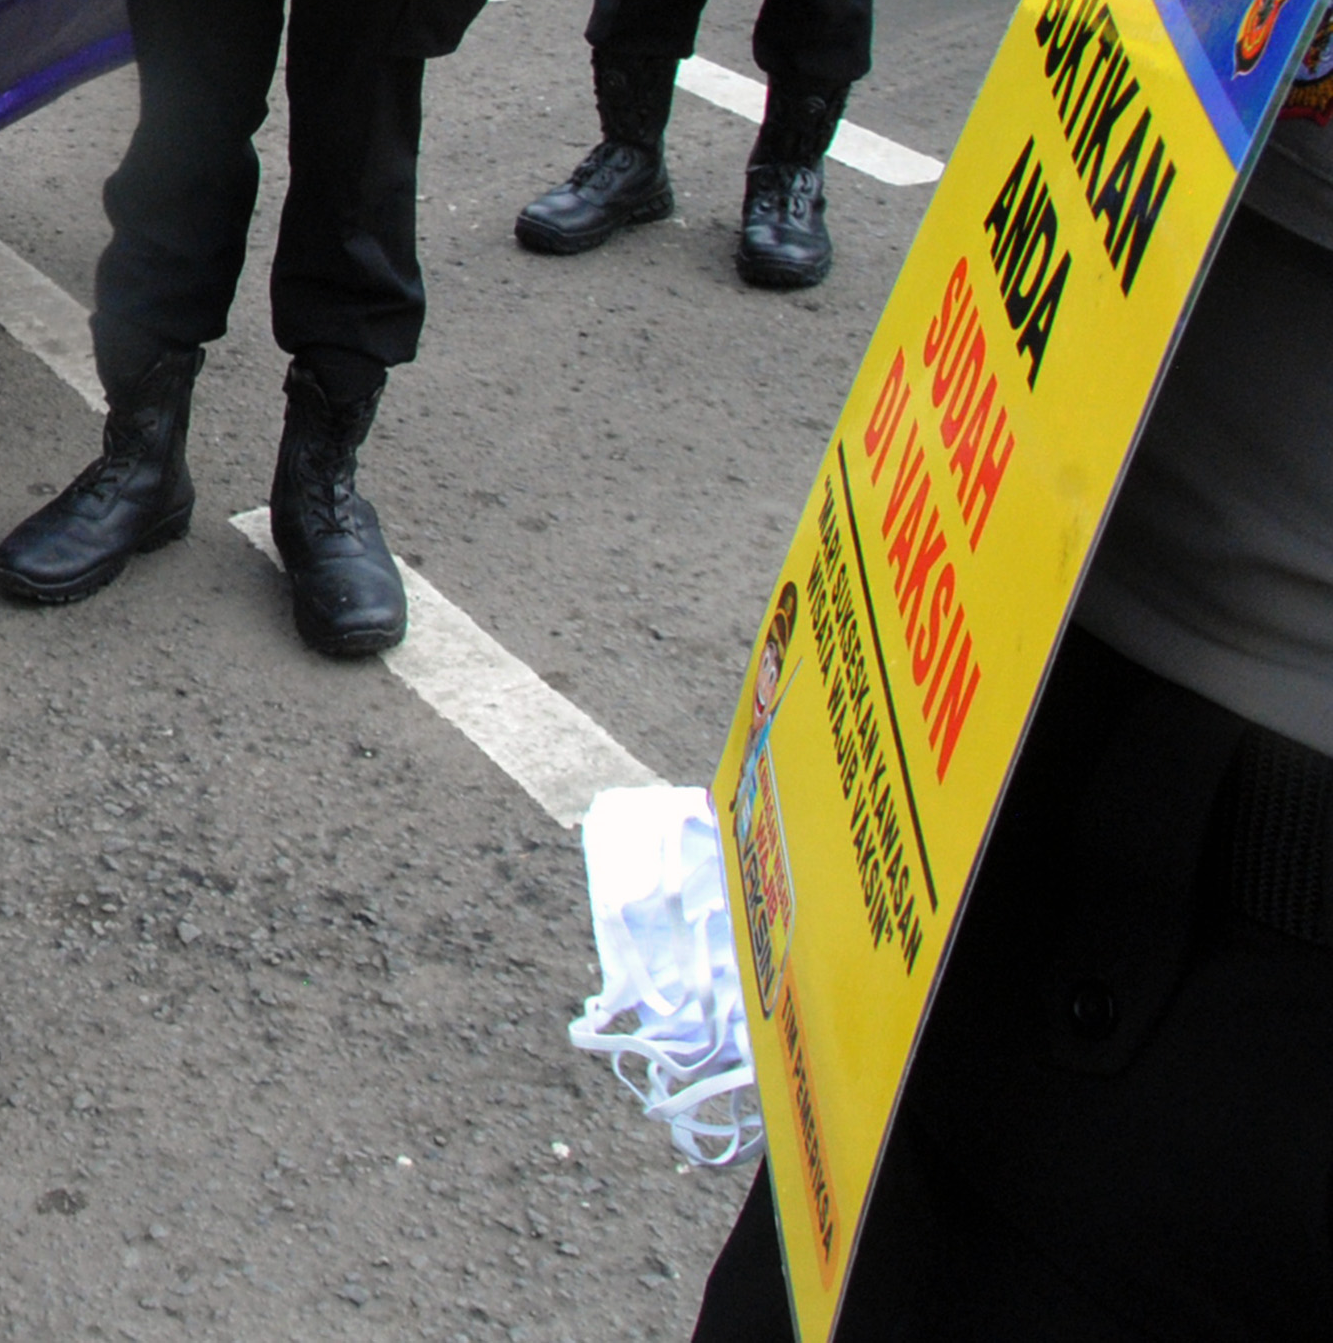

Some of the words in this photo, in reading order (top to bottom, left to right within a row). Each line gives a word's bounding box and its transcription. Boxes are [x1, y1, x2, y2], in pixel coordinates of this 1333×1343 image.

[983, 134, 1073, 394] ANDA
[864, 345, 911, 488] DI
[923, 256, 1016, 555] SUDAH
[806, 549, 836, 688] WISATA
[826, 663, 859, 801] WAJIB
[881, 417, 981, 787] VAKSIN
[831, 562, 881, 775] SUKSESKAN
[868, 751, 924, 977] KAWASAN
[793, 1044, 834, 1264] PEMERIKSA
